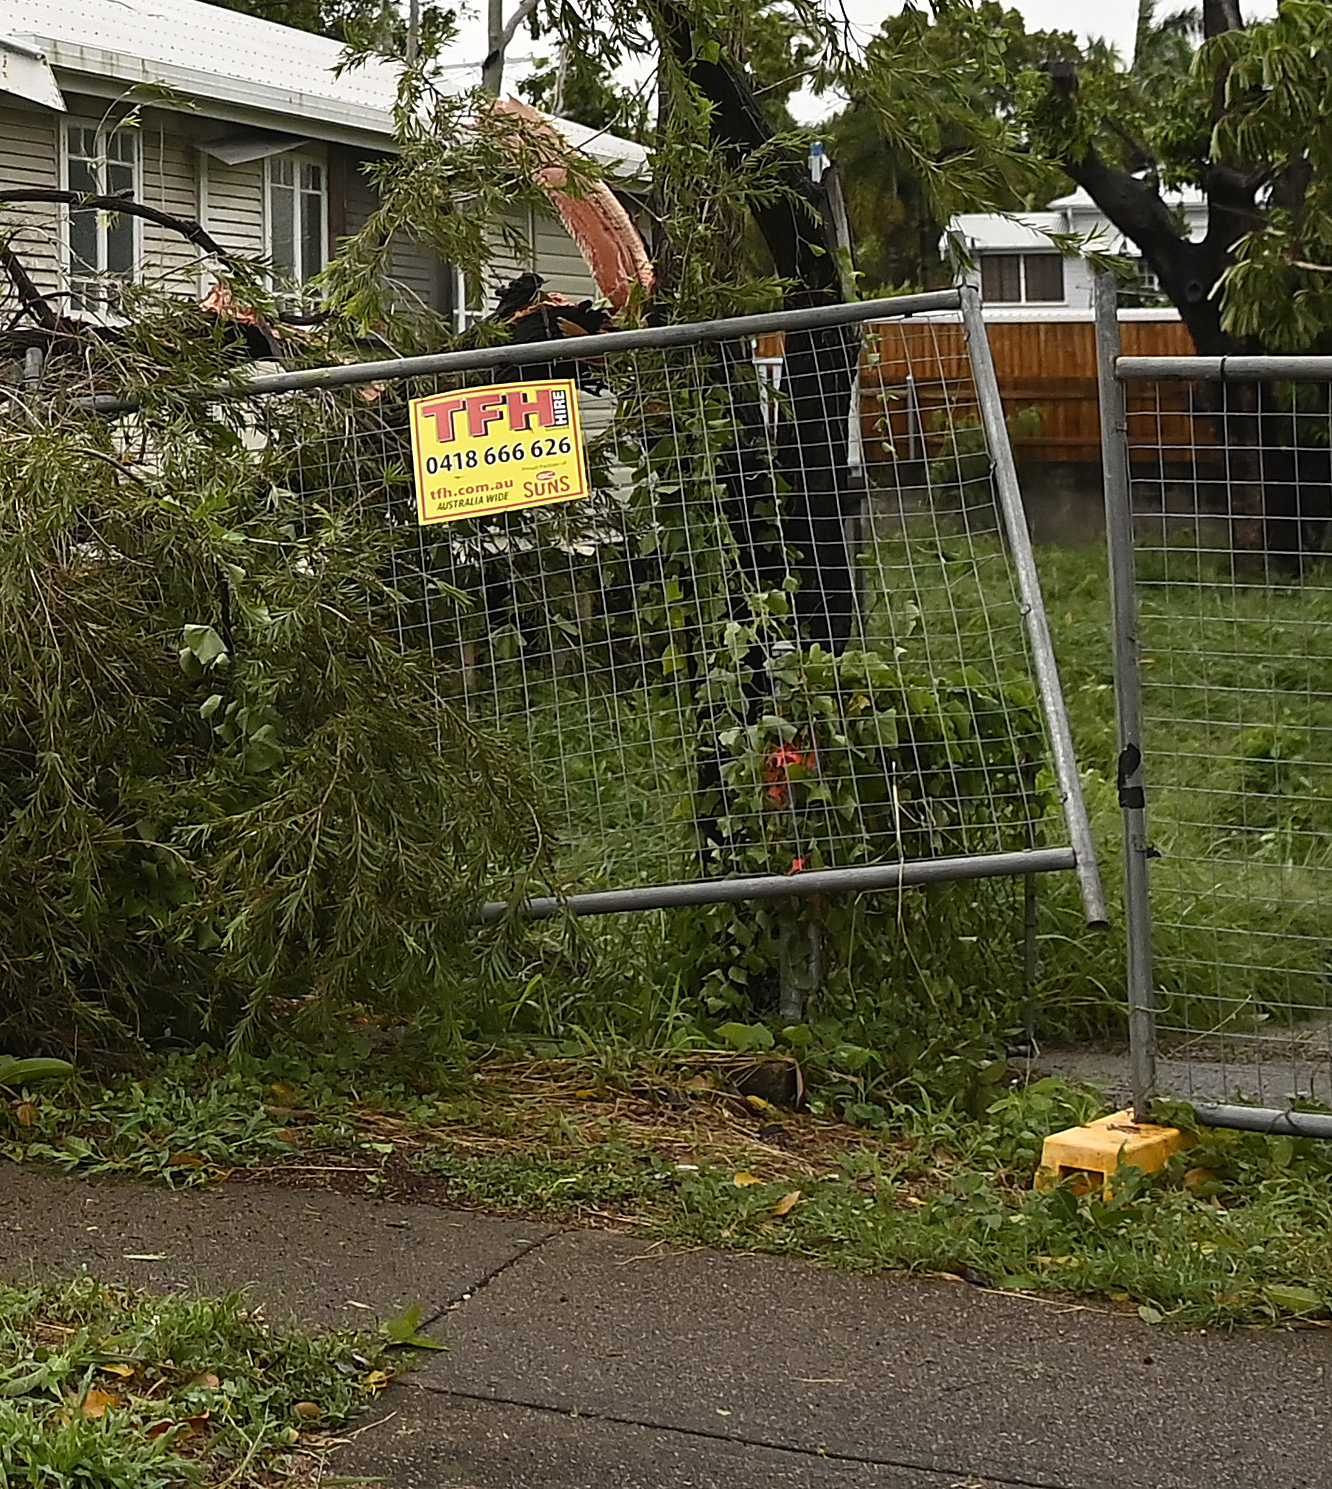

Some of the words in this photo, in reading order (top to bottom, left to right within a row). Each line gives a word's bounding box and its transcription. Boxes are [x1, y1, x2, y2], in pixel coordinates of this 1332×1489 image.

[422, 389, 555, 442] TFH
[552, 390, 568, 425] HIRE
[426, 449, 478, 474] 0418
[484, 443, 525, 465] 666
[530, 436, 571, 458] 626
[430, 479, 513, 500] tfh.com.au
[437, 495, 484, 511] AUSTRALIA
[486, 491, 509, 504] WIDE
[523, 475, 570, 498] SUNS
